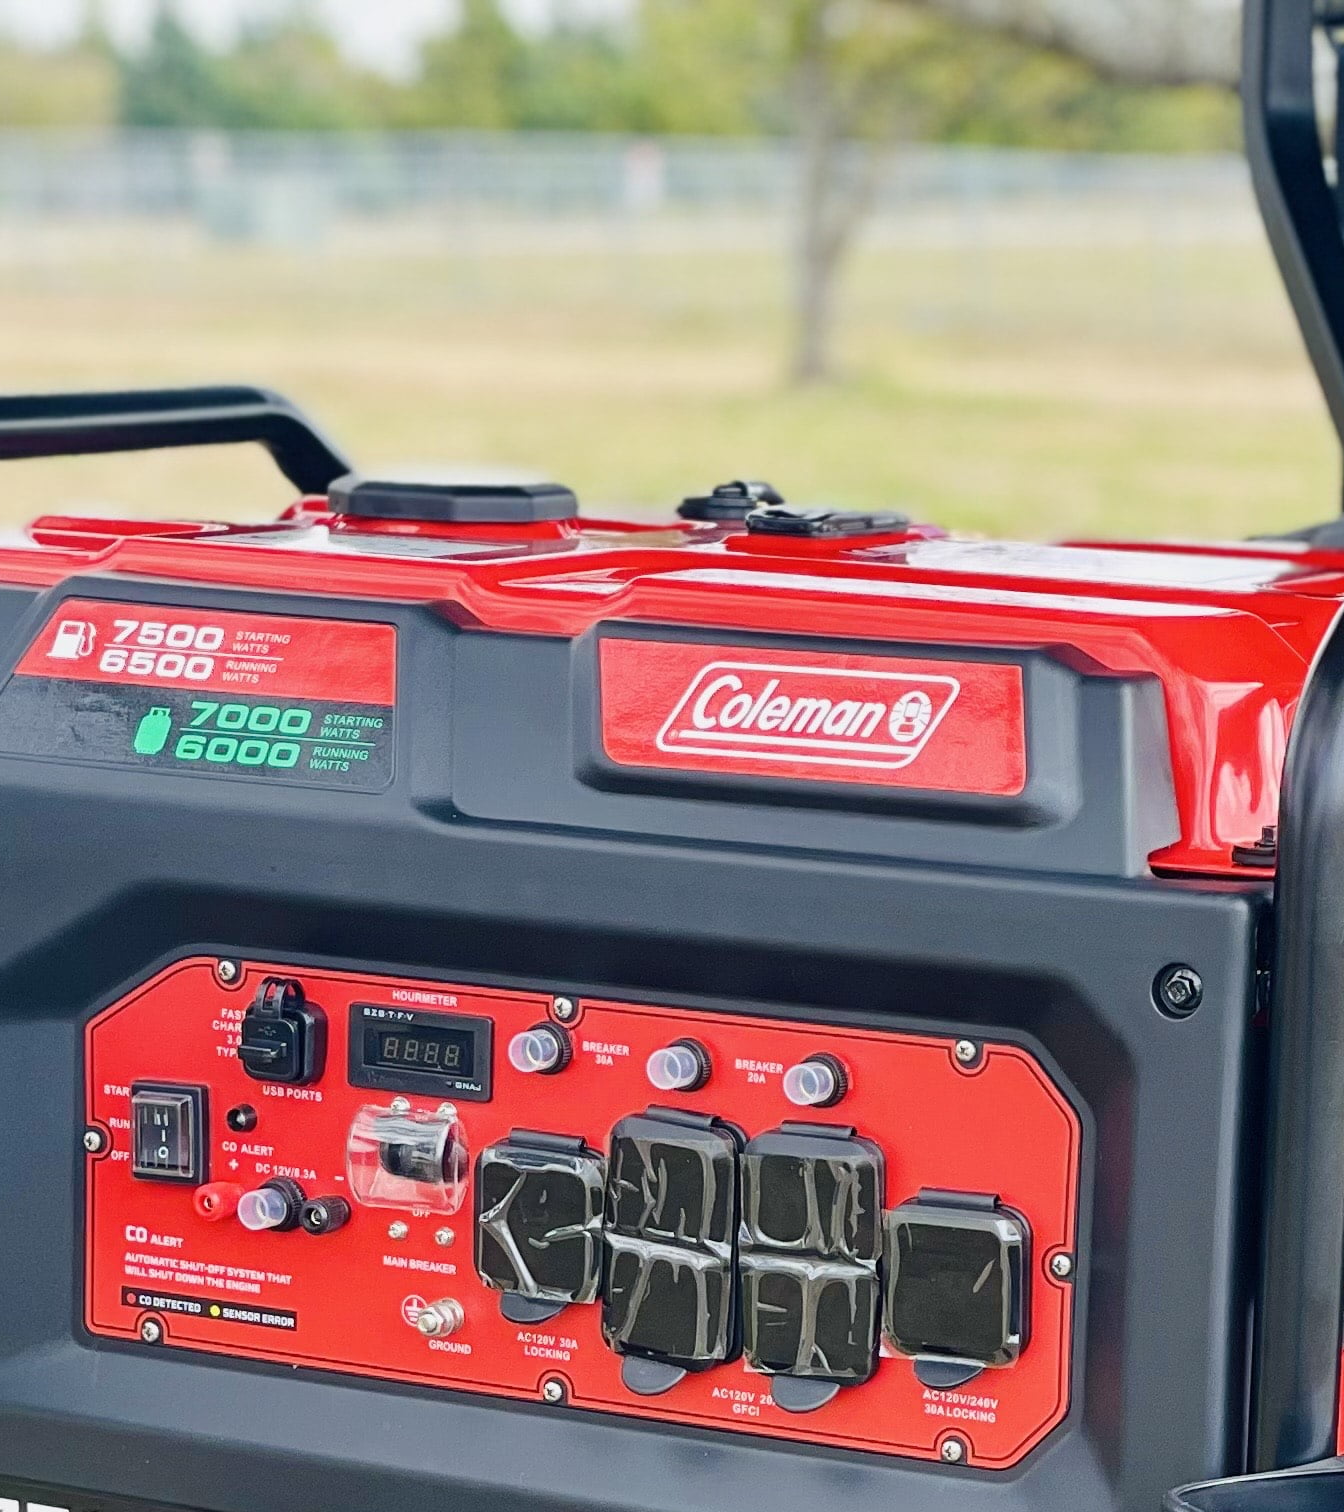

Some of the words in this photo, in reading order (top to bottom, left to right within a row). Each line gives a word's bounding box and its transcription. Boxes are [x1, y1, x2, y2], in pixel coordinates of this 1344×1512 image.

[113, 619, 226, 651] 7500
[236, 631, 291, 644] STARTING
[232, 642, 270, 654] WATTS
[99, 649, 216, 680] 6500
[226, 660, 277, 673] RUNNING
[222, 672, 260, 683] WATTS
[692, 675, 887, 738] Coleman
[189, 701, 313, 735] 7000
[324, 715, 384, 729] STARTING
[320, 727, 360, 739] WATTS
[175, 734, 302, 768] 6000
[313, 747, 369, 760] RUNNING
[309, 759, 350, 772] WATTS
[392, 990, 457, 1007] HOURMETER
[212, 1020, 242, 1032] CHAR
[216, 1047, 240, 1059] TYP
[582, 1040, 630, 1056] BREAKER
[595, 1054, 614, 1066] 30A
[735, 1058, 784, 1074] BREAKER
[747, 1072, 766, 1084] 20A
[103, 1084, 131, 1097] STAR
[262, 1086, 285, 1097] USB
[286, 1088, 323, 1102] PORTS
[109, 1118, 131, 1129] RUN
[110, 1151, 130, 1161] OFF
[222, 1141, 238, 1152] CO
[241, 1143, 274, 1157] ALERT
[255, 1162, 271, 1174] DC
[125, 1225, 148, 1243] CO
[150, 1234, 184, 1249] ALERT
[124, 1252, 179, 1268] AUTOMATIC
[180, 1261, 226, 1275] SHUT-OFF
[227, 1266, 266, 1282] SYSTEM
[267, 1273, 293, 1285] THAT
[383, 1255, 407, 1268] MAIN
[408, 1258, 457, 1275] BREAKER
[124, 1264, 148, 1277] WILL
[149, 1269, 175, 1281] SHUT
[175, 1274, 205, 1286] DOWN
[205, 1278, 225, 1289] THE
[226, 1281, 261, 1294] ENGINE
[139, 1294, 152, 1306] CO
[153, 1297, 202, 1313] DETECTED
[222, 1308, 261, 1322] SENSOR
[262, 1313, 295, 1328] ERROR
[428, 1339, 472, 1355] GROUND
[516, 1331, 556, 1346] AC120V
[559, 1337, 579, 1350] 30A
[524, 1345, 571, 1361] LOCKING
[711, 1387, 755, 1402] AC120V
[759, 1394, 776, 1406] 20
[922, 1389, 999, 1409] AC120V/240V
[732, 1403, 760, 1416] GFCI
[924, 1403, 945, 1416] 30A
[946, 1406, 996, 1423] LOCKING
